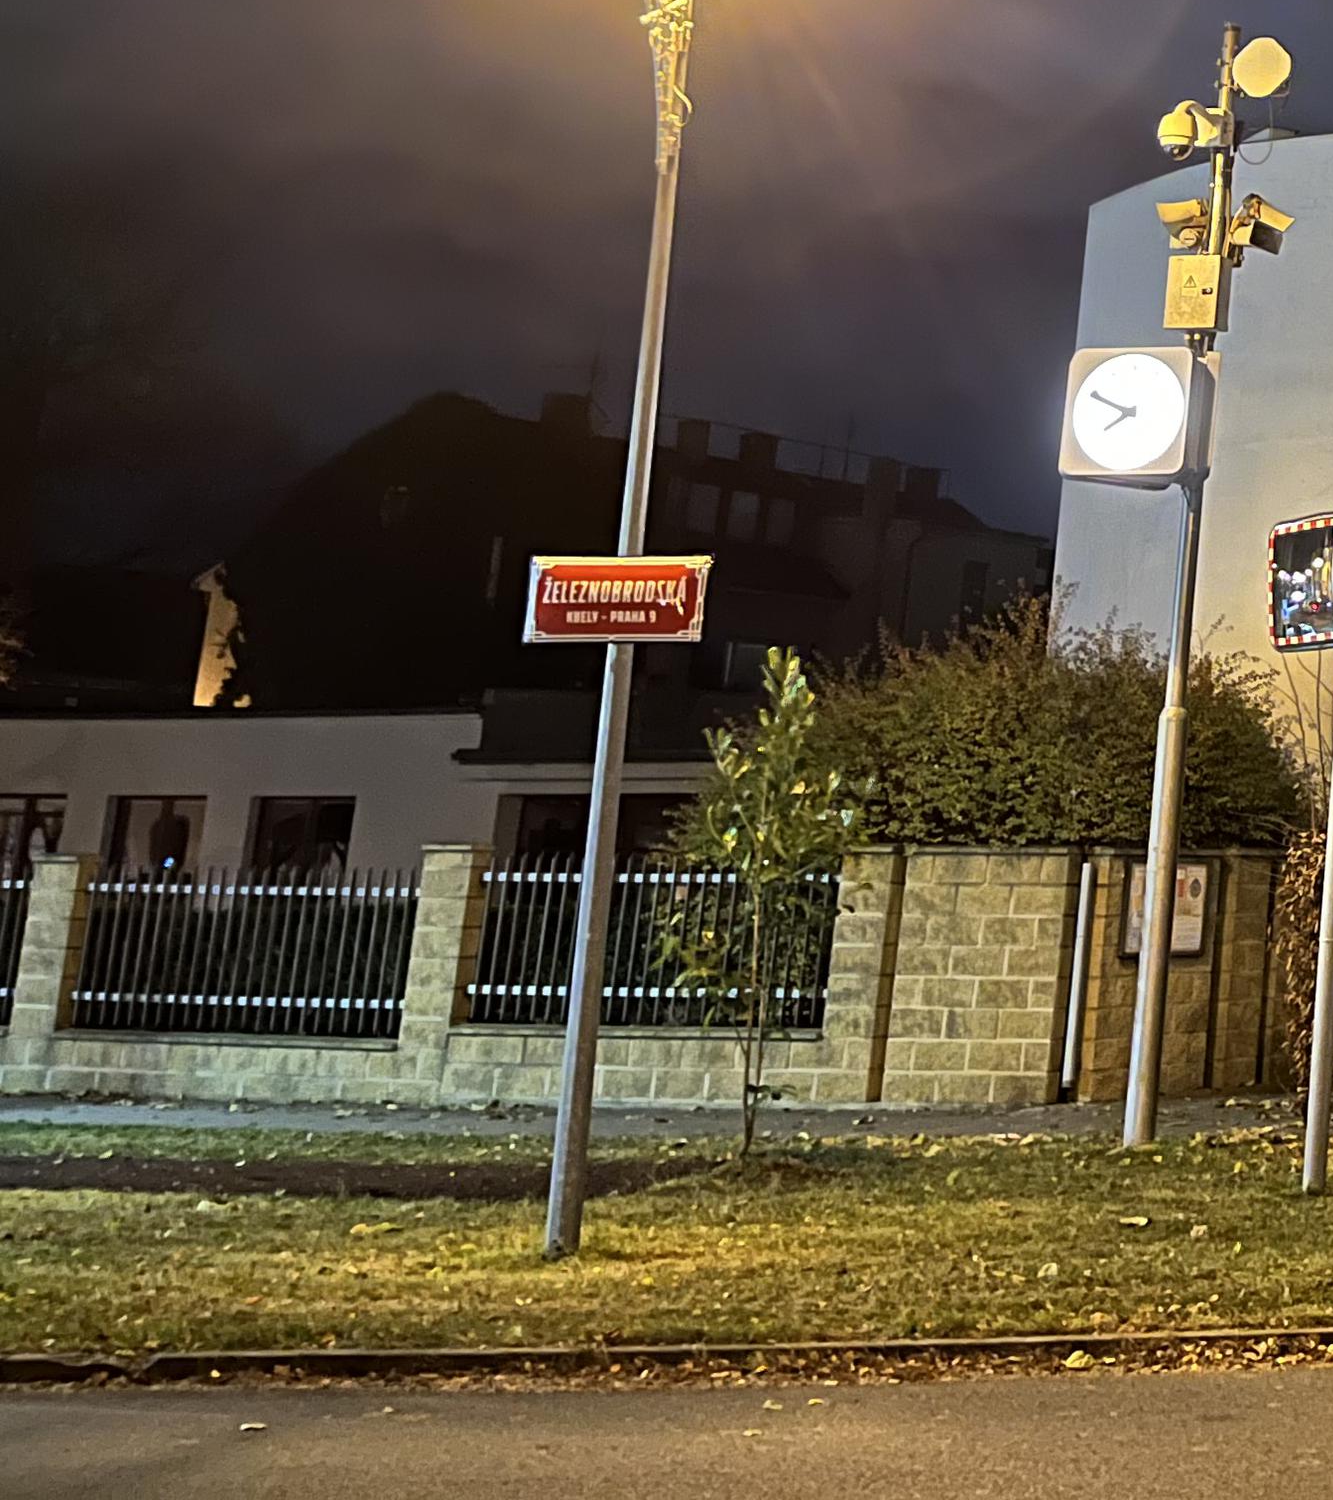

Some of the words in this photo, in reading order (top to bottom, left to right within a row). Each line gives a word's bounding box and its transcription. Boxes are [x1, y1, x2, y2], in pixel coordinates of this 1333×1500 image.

[542, 576, 687, 604] ŽELEZNOBRODSKÁ
[566, 610, 599, 623] KBELY
[609, 610, 646, 623] PRAHA
[650, 610, 656, 623] 9
